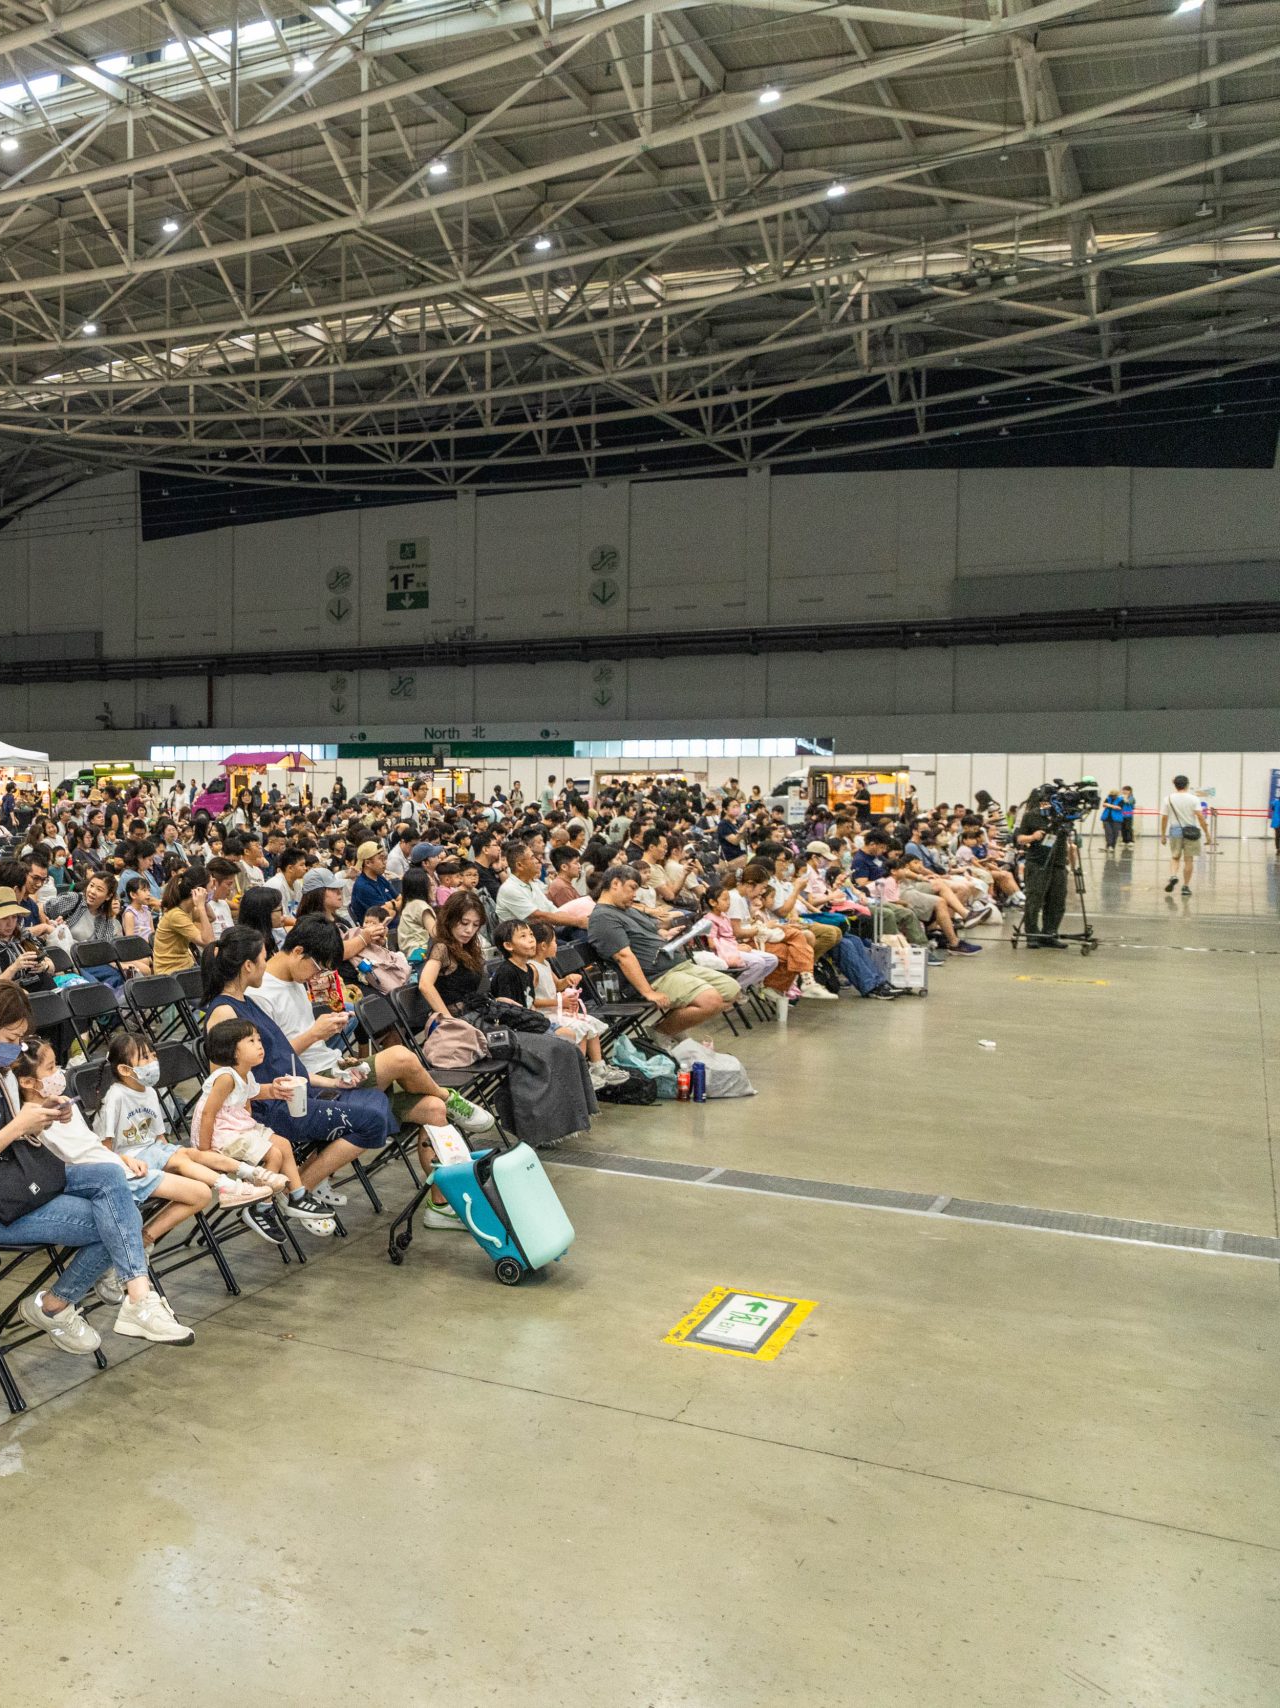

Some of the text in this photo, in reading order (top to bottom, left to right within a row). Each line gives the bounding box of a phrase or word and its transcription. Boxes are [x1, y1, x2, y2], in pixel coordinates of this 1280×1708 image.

[390, 573, 415, 590] 1F
[424, 727, 460, 740] North
[471, 725, 486, 739] 北
